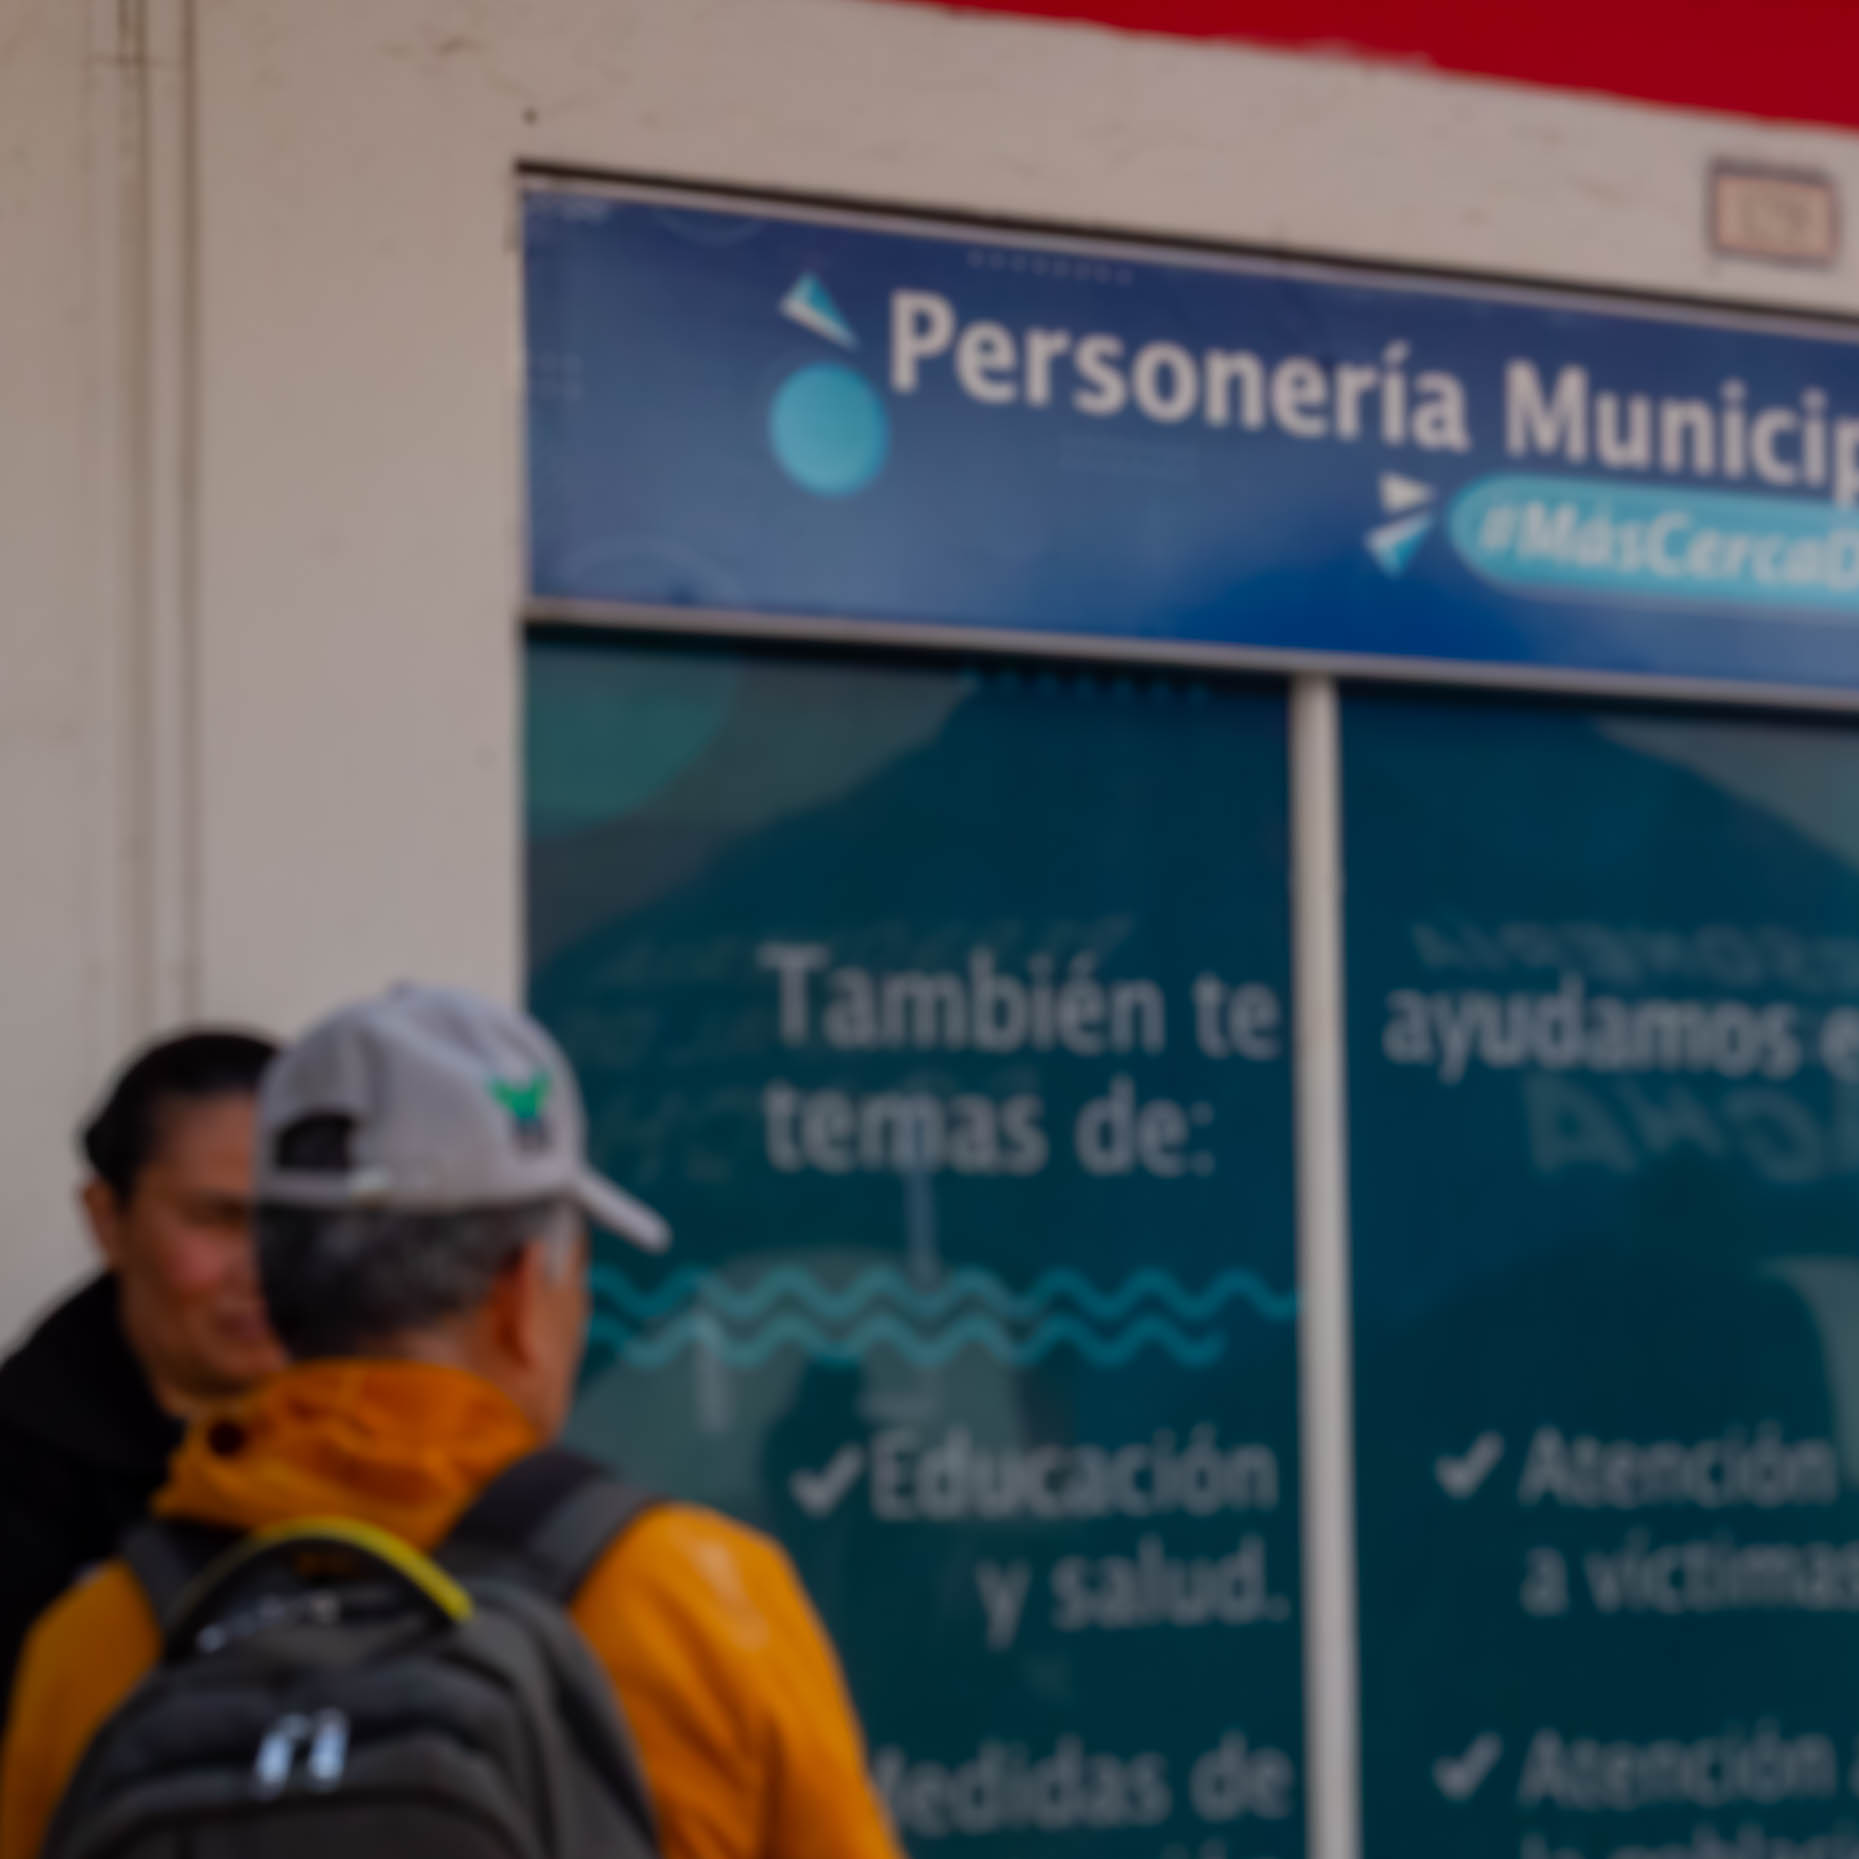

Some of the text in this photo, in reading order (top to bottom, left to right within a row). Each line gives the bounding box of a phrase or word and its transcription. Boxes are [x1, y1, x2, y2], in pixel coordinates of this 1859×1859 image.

[890, 290, 1467, 451] Personería
[758, 945, 1163, 1052] También
[1194, 974, 1279, 1057] te
[1385, 976, 1799, 1082] ayudamos
[765, 1079, 1211, 1173] temas de:
[872, 1426, 1276, 1519] Educación
[1520, 1423, 1836, 1505] Atención
[981, 1538, 1288, 1647] y salud.
[1525, 1549, 1566, 1612] a
[1191, 1734, 1292, 1818] de
[1522, 1722, 1835, 1807] Atención
